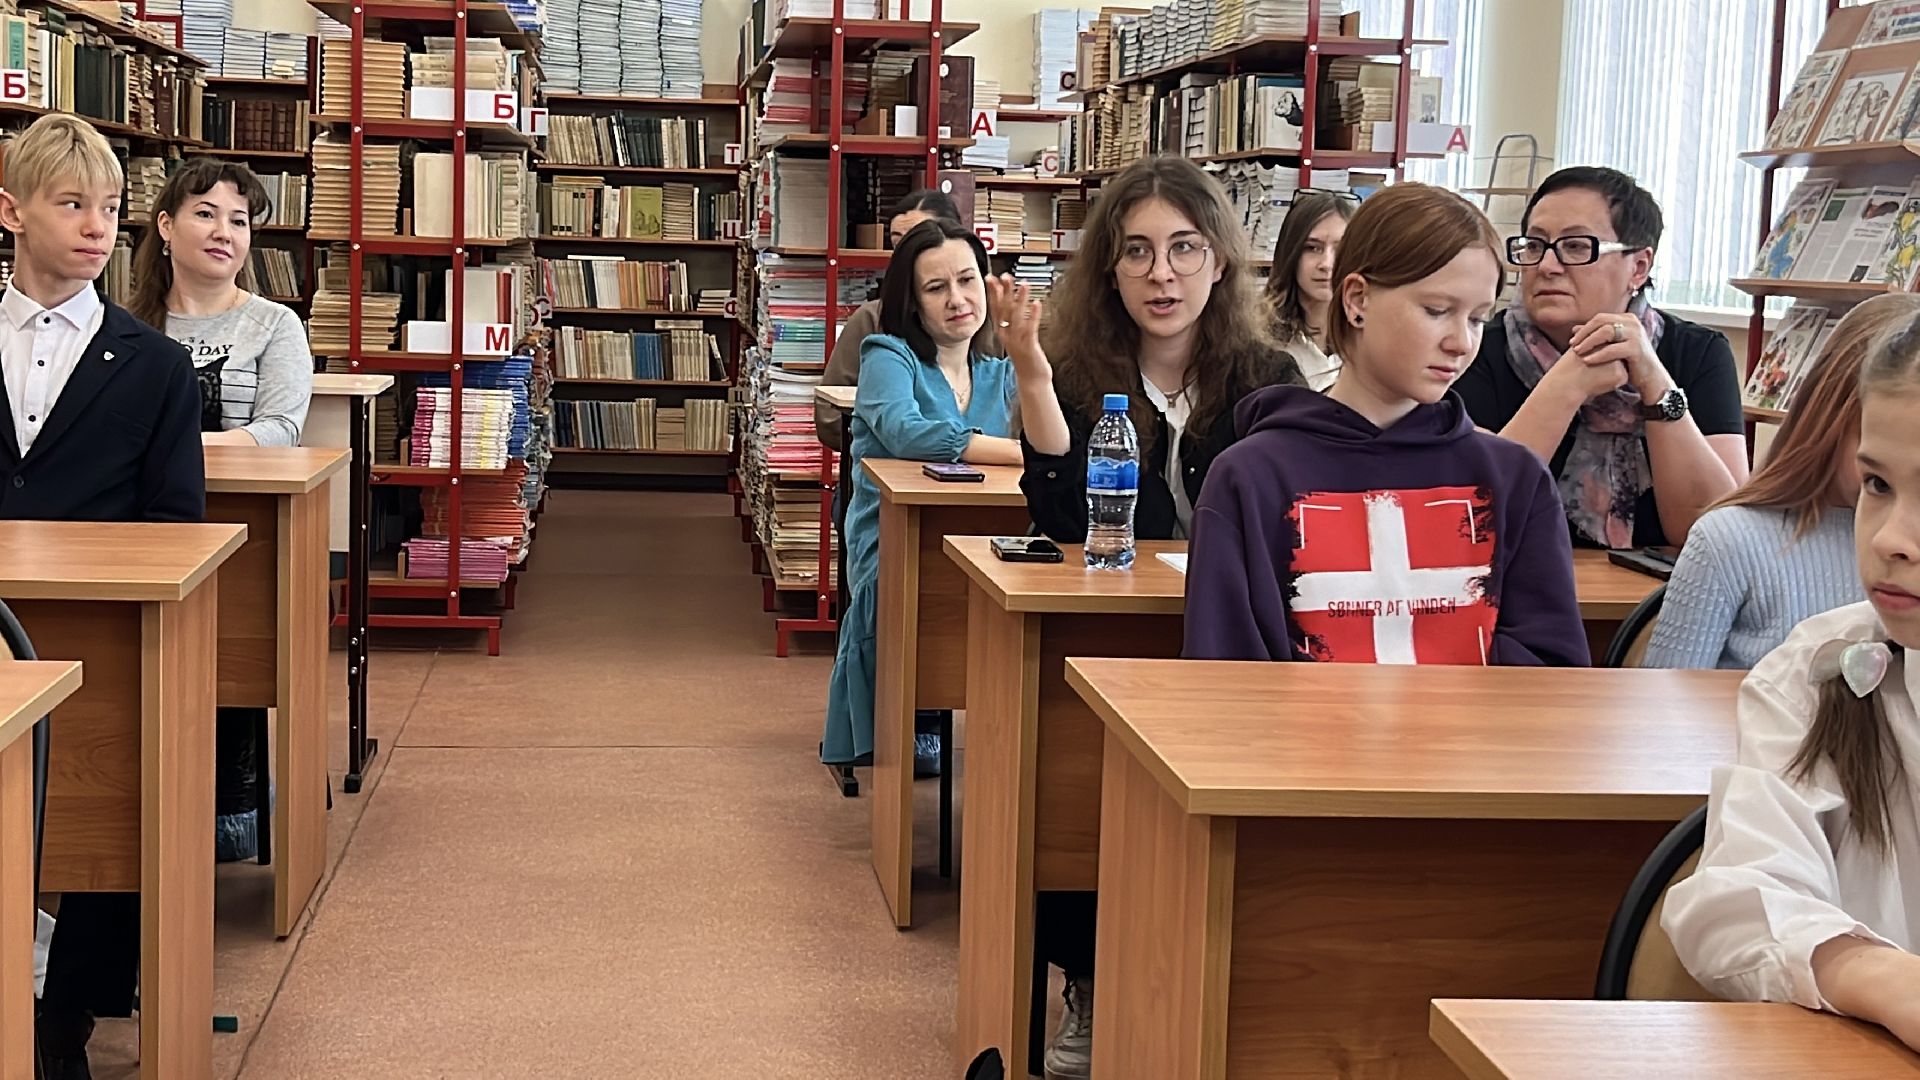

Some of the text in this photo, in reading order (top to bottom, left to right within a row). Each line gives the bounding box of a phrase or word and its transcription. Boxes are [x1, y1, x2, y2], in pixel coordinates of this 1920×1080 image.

[4, 73, 26, 98] Б
[1061, 71, 1076, 90] С
[494, 94, 514, 119] Б
[531, 110, 546, 132] Г
[971, 112, 993, 136] А
[1446, 127, 1468, 152] А
[727, 146, 739, 163] Т
[1044, 155, 1058, 172] С
[1053, 231, 1065, 249] Т
[486, 326, 509, 351] М
[199, 344, 234, 356] DAY
[1407, 596, 1456, 616] VINDEN
